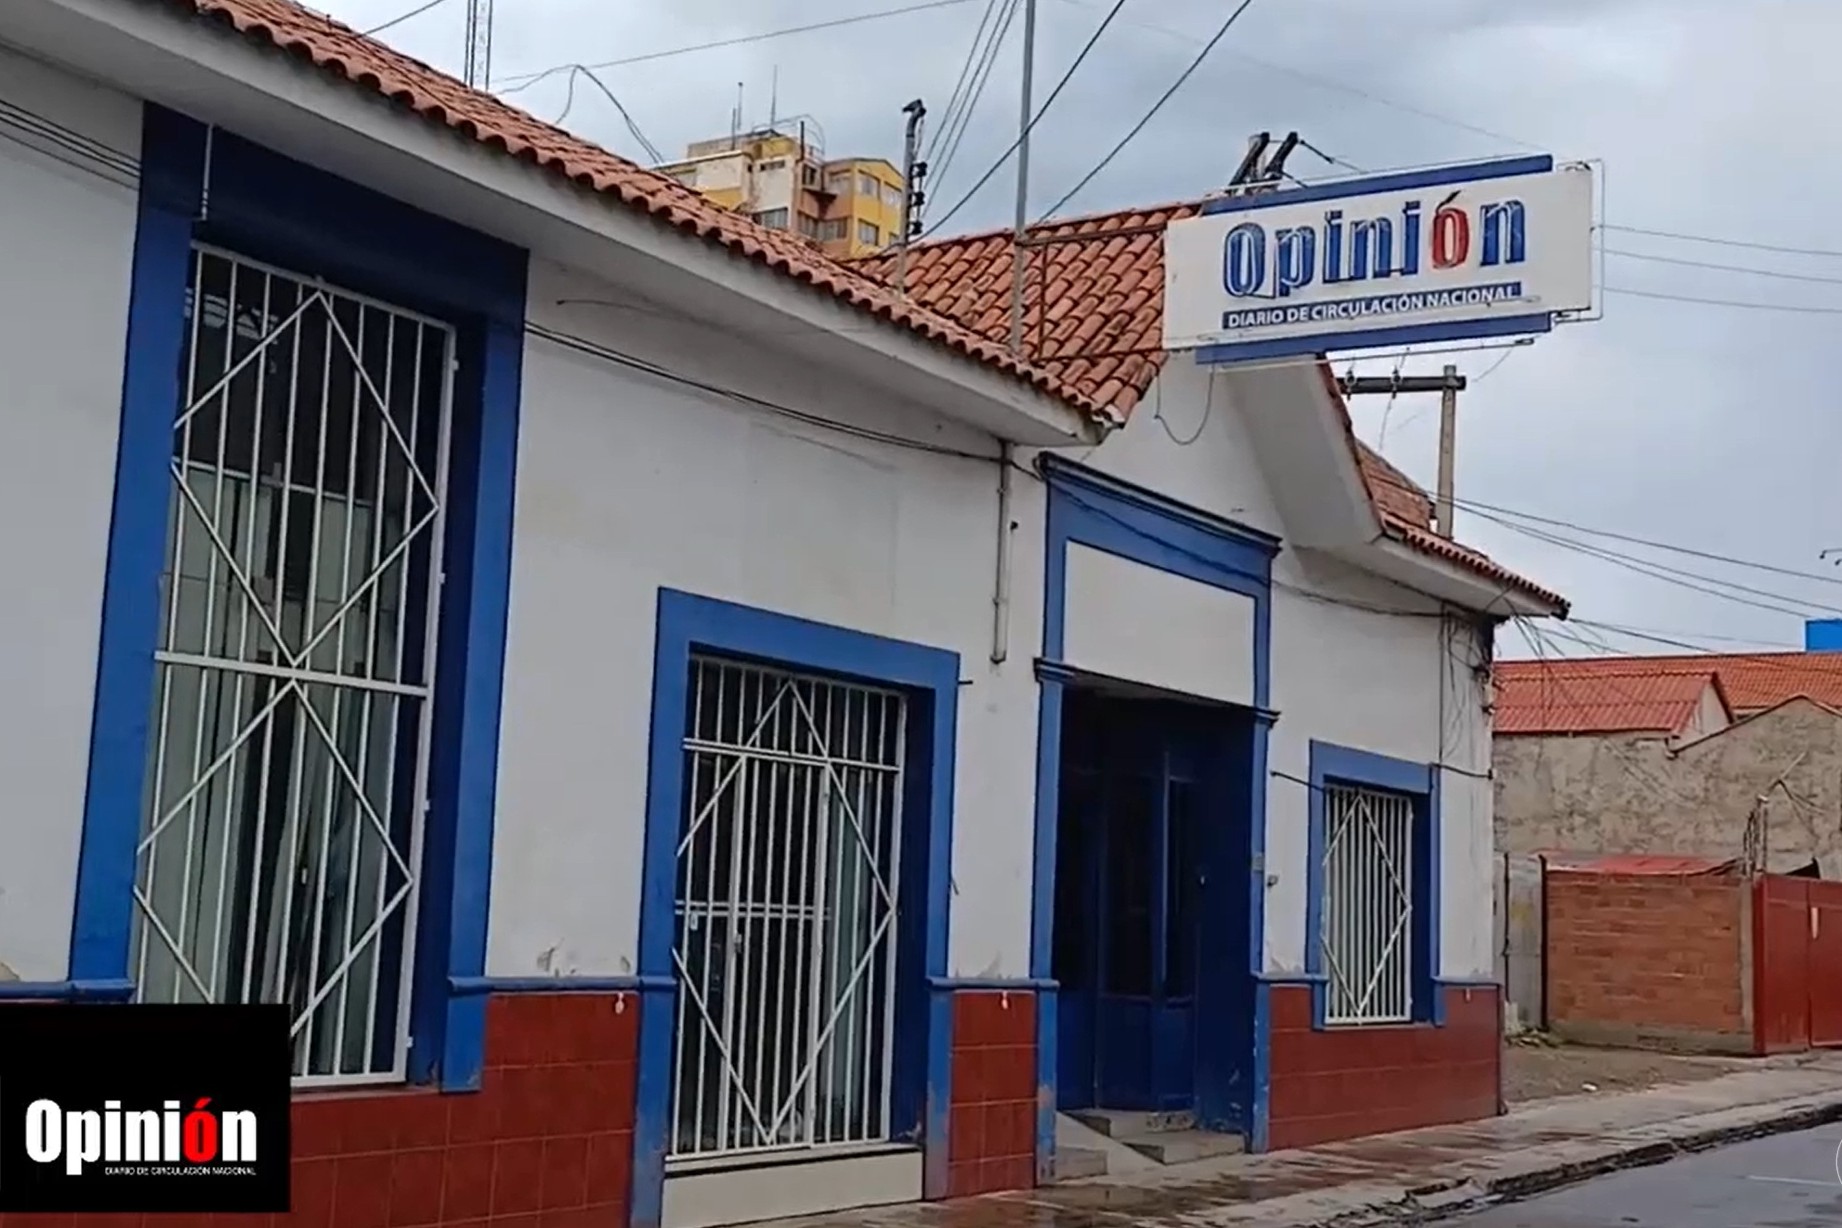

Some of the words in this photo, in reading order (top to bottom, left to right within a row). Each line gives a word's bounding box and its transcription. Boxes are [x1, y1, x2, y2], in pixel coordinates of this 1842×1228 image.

[1223, 190, 1526, 299] Opinión
[1228, 309, 1284, 328] DIARIO
[1287, 306, 1309, 322] DE
[1311, 292, 1423, 320] CIRCULACIÓN
[1426, 286, 1518, 308] NACIONAL
